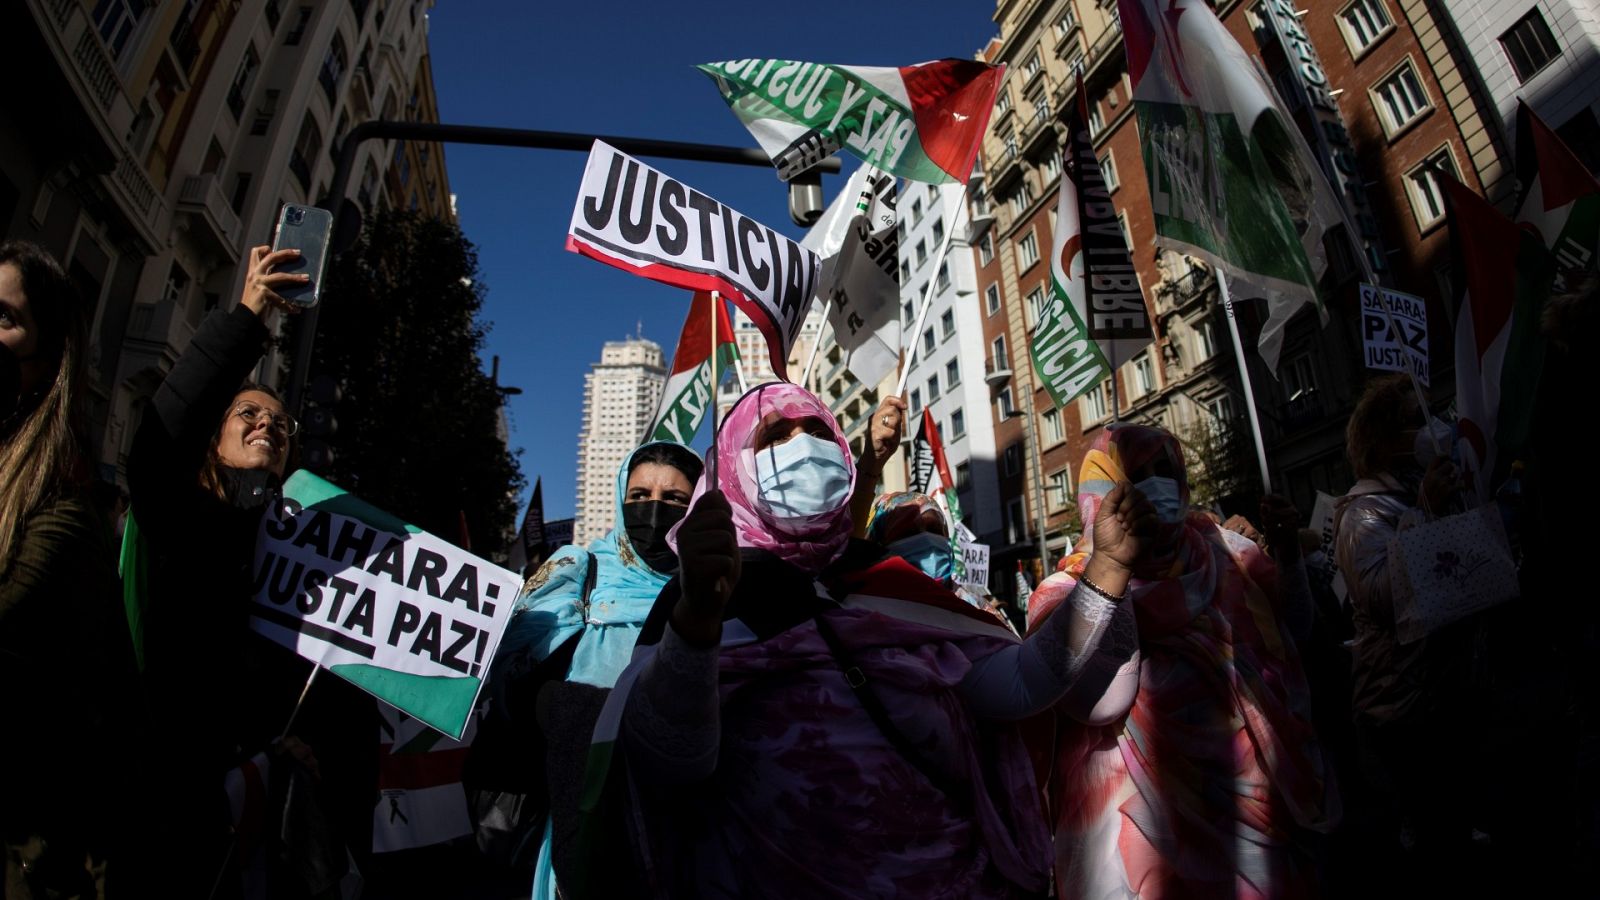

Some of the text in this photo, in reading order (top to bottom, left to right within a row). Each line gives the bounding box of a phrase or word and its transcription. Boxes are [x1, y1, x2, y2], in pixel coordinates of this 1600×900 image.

[1322, 119, 1388, 273] HOTEL
[1363, 290, 1426, 322] SAHARA:
[1365, 314, 1427, 356] PAZ
[252, 552, 489, 677] JUSTA PAZ!
[266, 497, 500, 617] SAHARA:
